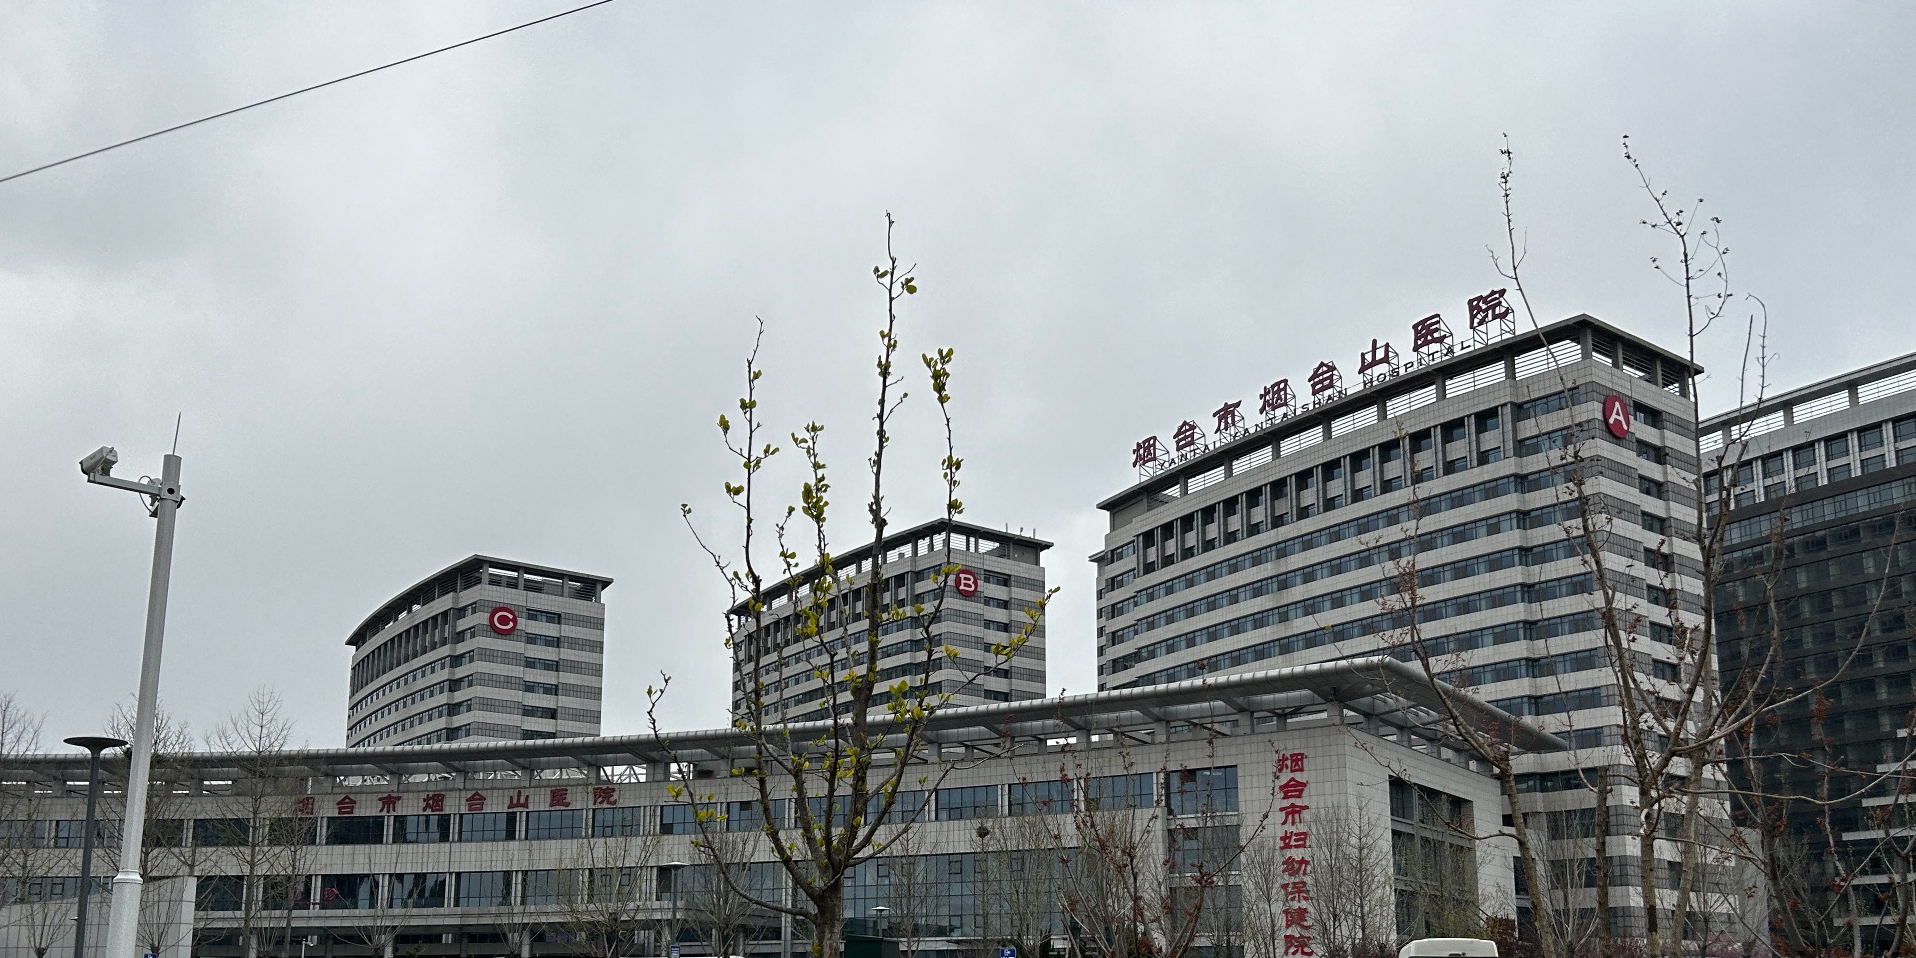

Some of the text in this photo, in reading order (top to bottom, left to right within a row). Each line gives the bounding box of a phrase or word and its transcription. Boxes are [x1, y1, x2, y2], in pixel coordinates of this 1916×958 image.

[1132, 288, 1510, 468] 烟台市烟台山医院
[1158, 440, 1217, 470] YANTAI
[1364, 341, 1471, 388] HOSPITAL
[1608, 401, 1628, 430] A
[493, 611, 514, 629] C
[959, 573, 976, 592] B
[1277, 752, 1314, 957] 烟台市妇幼保健院
